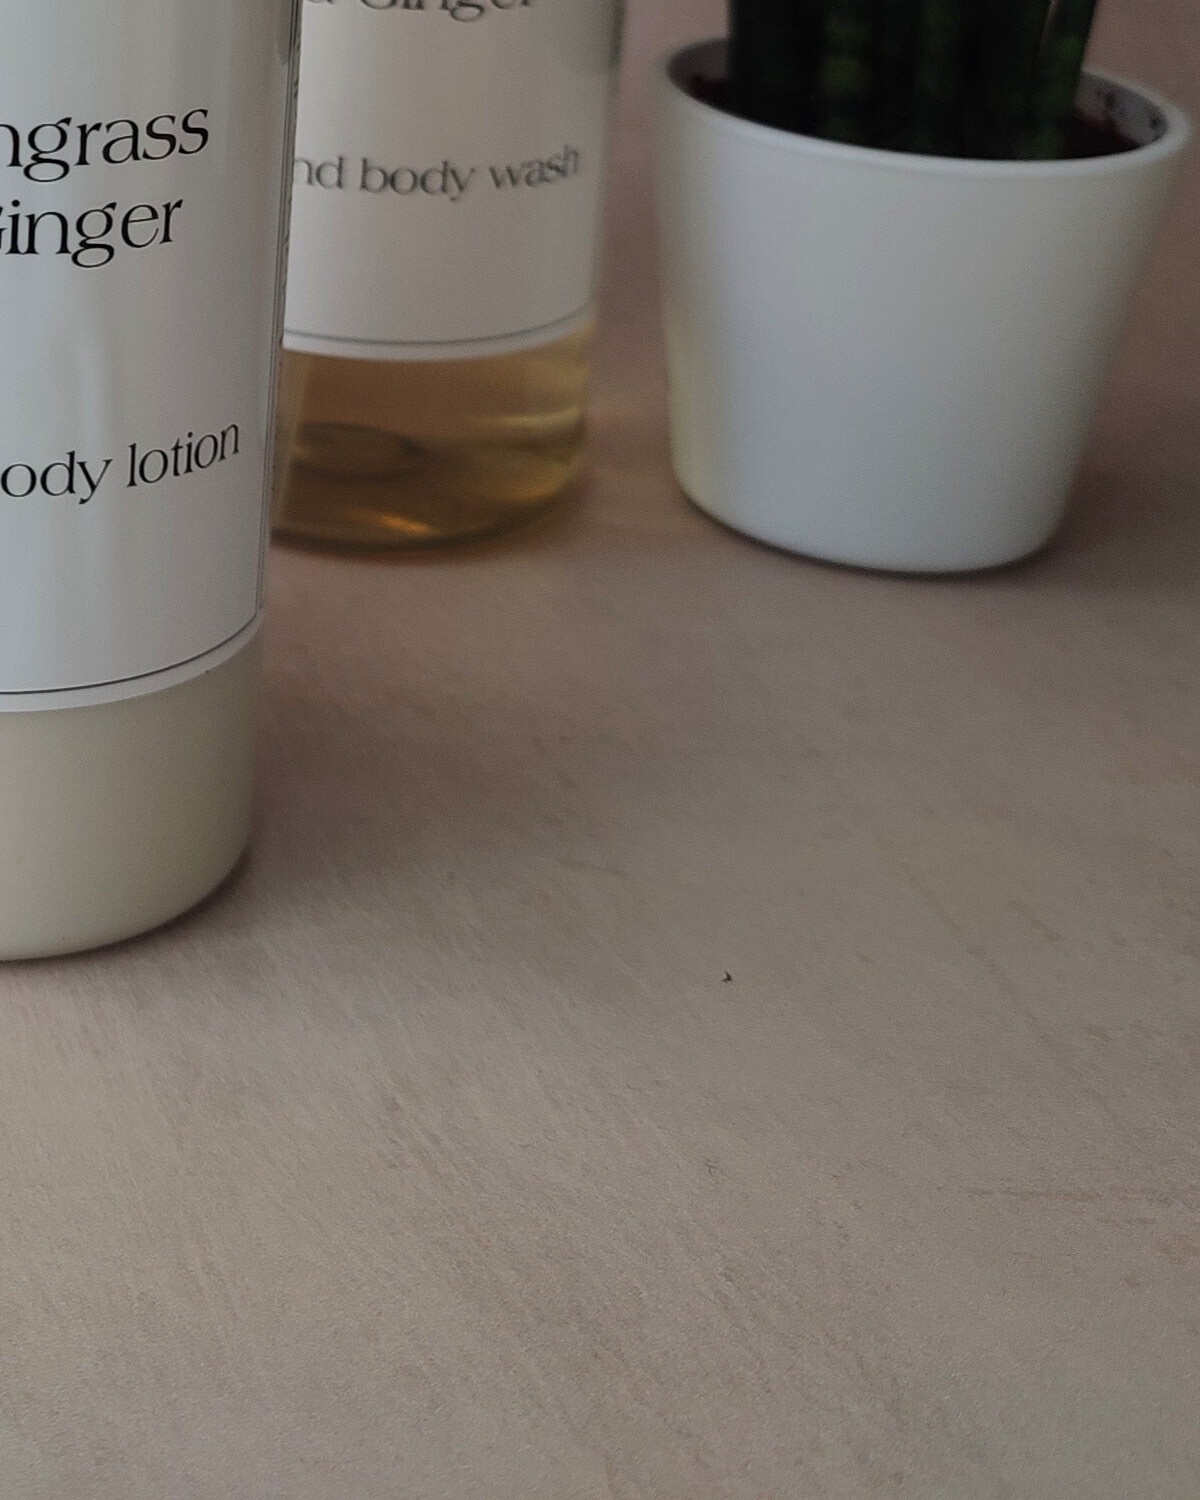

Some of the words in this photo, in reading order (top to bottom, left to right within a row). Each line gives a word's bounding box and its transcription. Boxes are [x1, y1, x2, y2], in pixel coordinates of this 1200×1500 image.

[360, 158, 476, 202] body
[489, 145, 580, 190] wash
[125, 423, 241, 488] lotion
